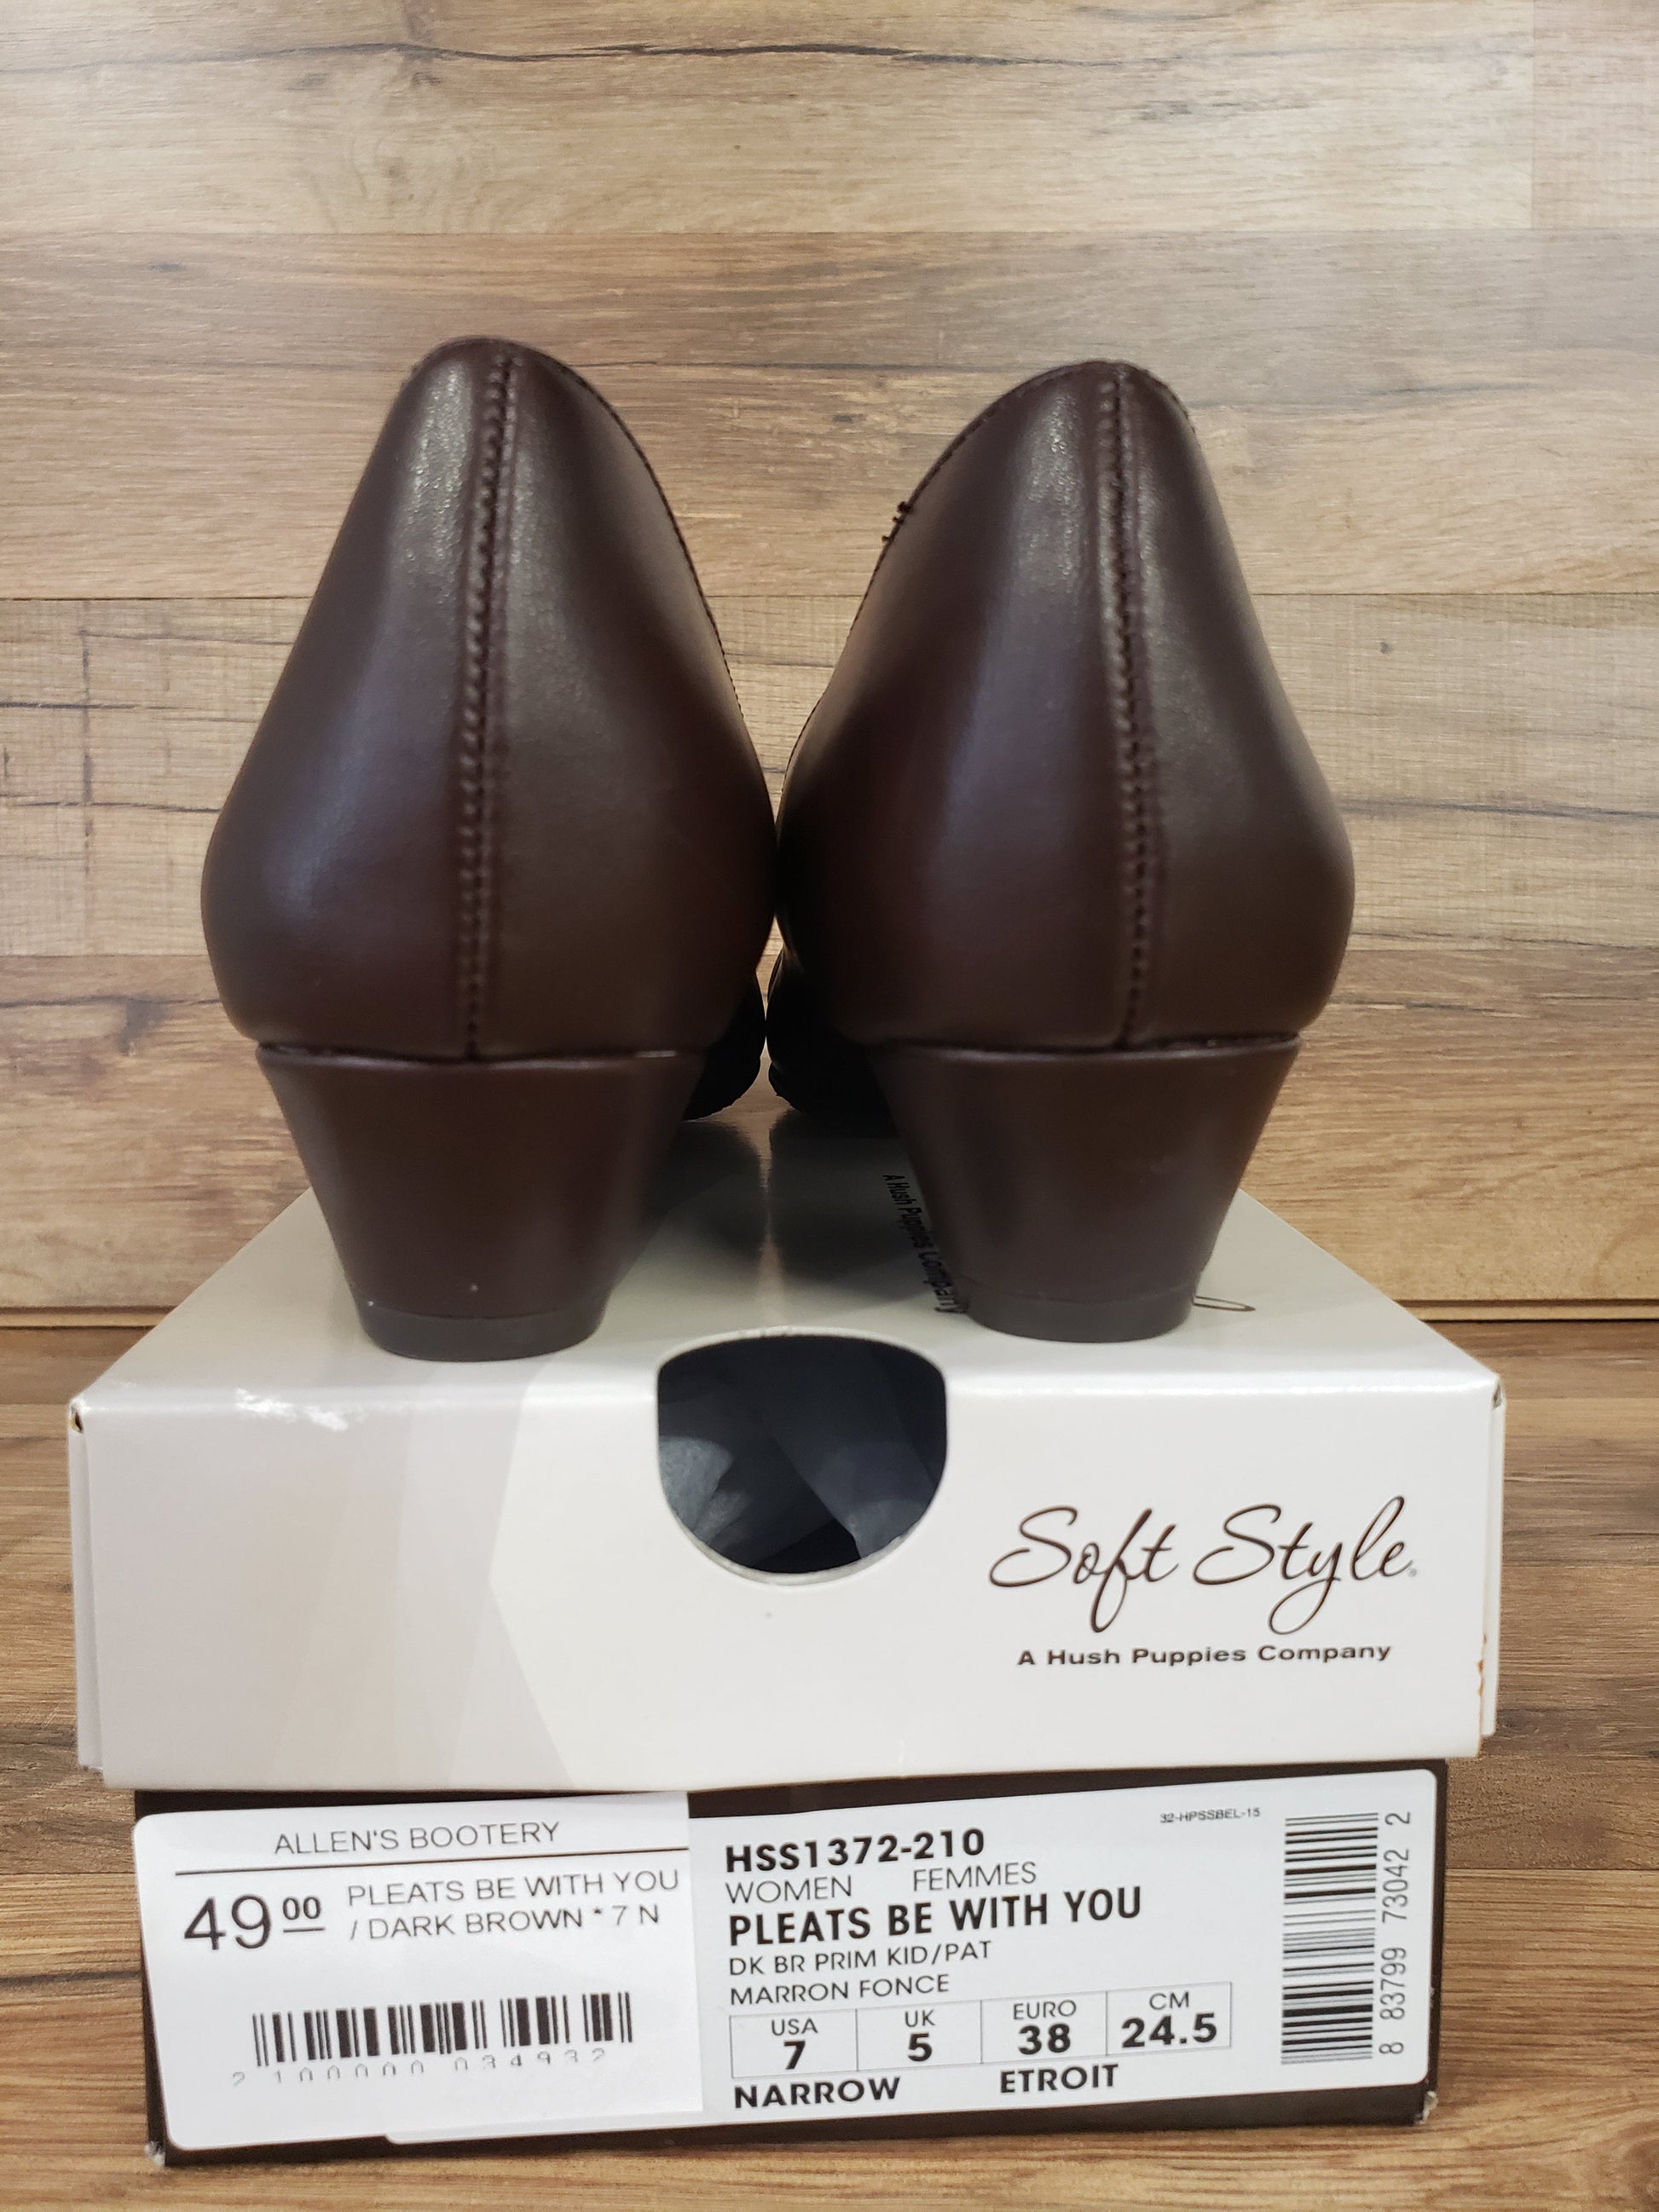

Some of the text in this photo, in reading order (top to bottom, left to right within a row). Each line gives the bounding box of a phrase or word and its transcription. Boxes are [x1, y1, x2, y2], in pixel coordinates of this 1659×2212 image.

[887, 1182, 916, 1205] Hush
[989, 1495, 1413, 1635] Soft Style
[1017, 1644, 1392, 1667] A Hush Puppies Company
[274, 1821, 561, 1856] ALLEN'S BOOTERY
[725, 1828, 986, 1874] HSS1372-210
[348, 1868, 679, 1907] PLEATS BE WITH YOU
[725, 1861, 1037, 1903] WOMEN FEMMES
[368, 1914, 455, 1940] DARK
[465, 1907, 584, 1936] BROWN
[613, 1904, 628, 1926] 7
[640, 1903, 661, 1925] N
[730, 1885, 1142, 1947] PLEATS BE WITH YOU
[1379, 1811, 1412, 2055] 8 83799 73042 2
[730, 1940, 993, 1977] DK BR PRIM KID/PAT
[731, 1973, 951, 2005] MARRON FONCE
[771, 1990, 1190, 2036] USA UK EURO CM
[783, 2012, 1218, 2071] 7 5 38 24.5
[734, 2063, 1119, 2110] NARROW ETROIT
